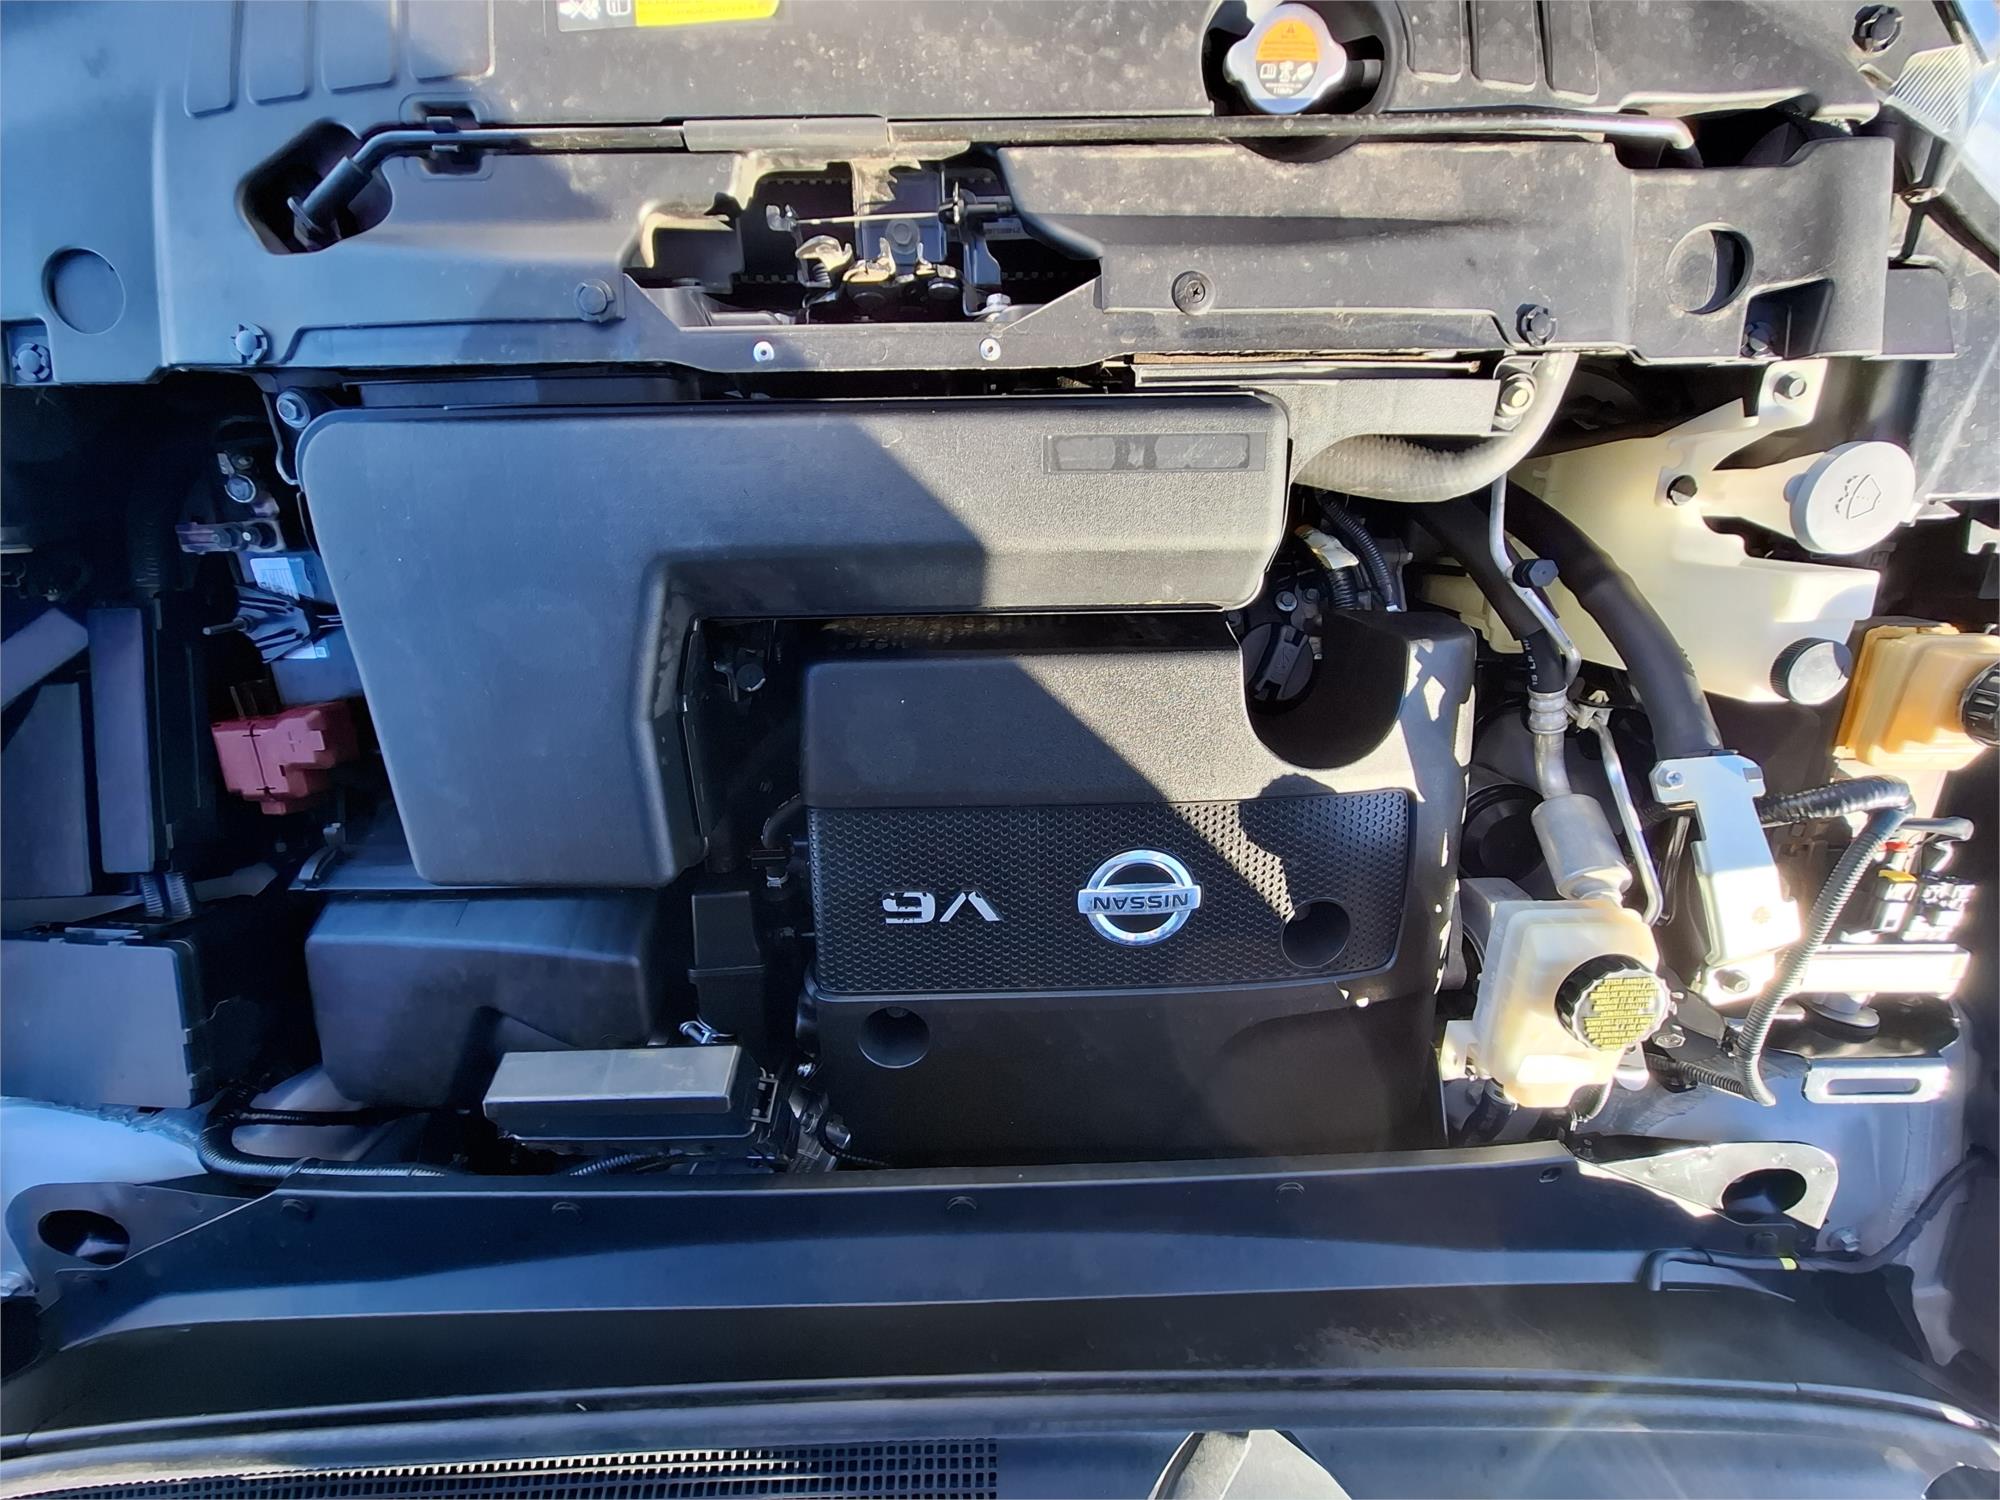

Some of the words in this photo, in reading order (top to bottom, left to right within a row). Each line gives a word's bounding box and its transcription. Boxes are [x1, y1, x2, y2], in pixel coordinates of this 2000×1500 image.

[1527, 655, 1536, 669] LP
[882, 891, 1000, 924] V6
[1093, 893, 1189, 910] NISSAN
